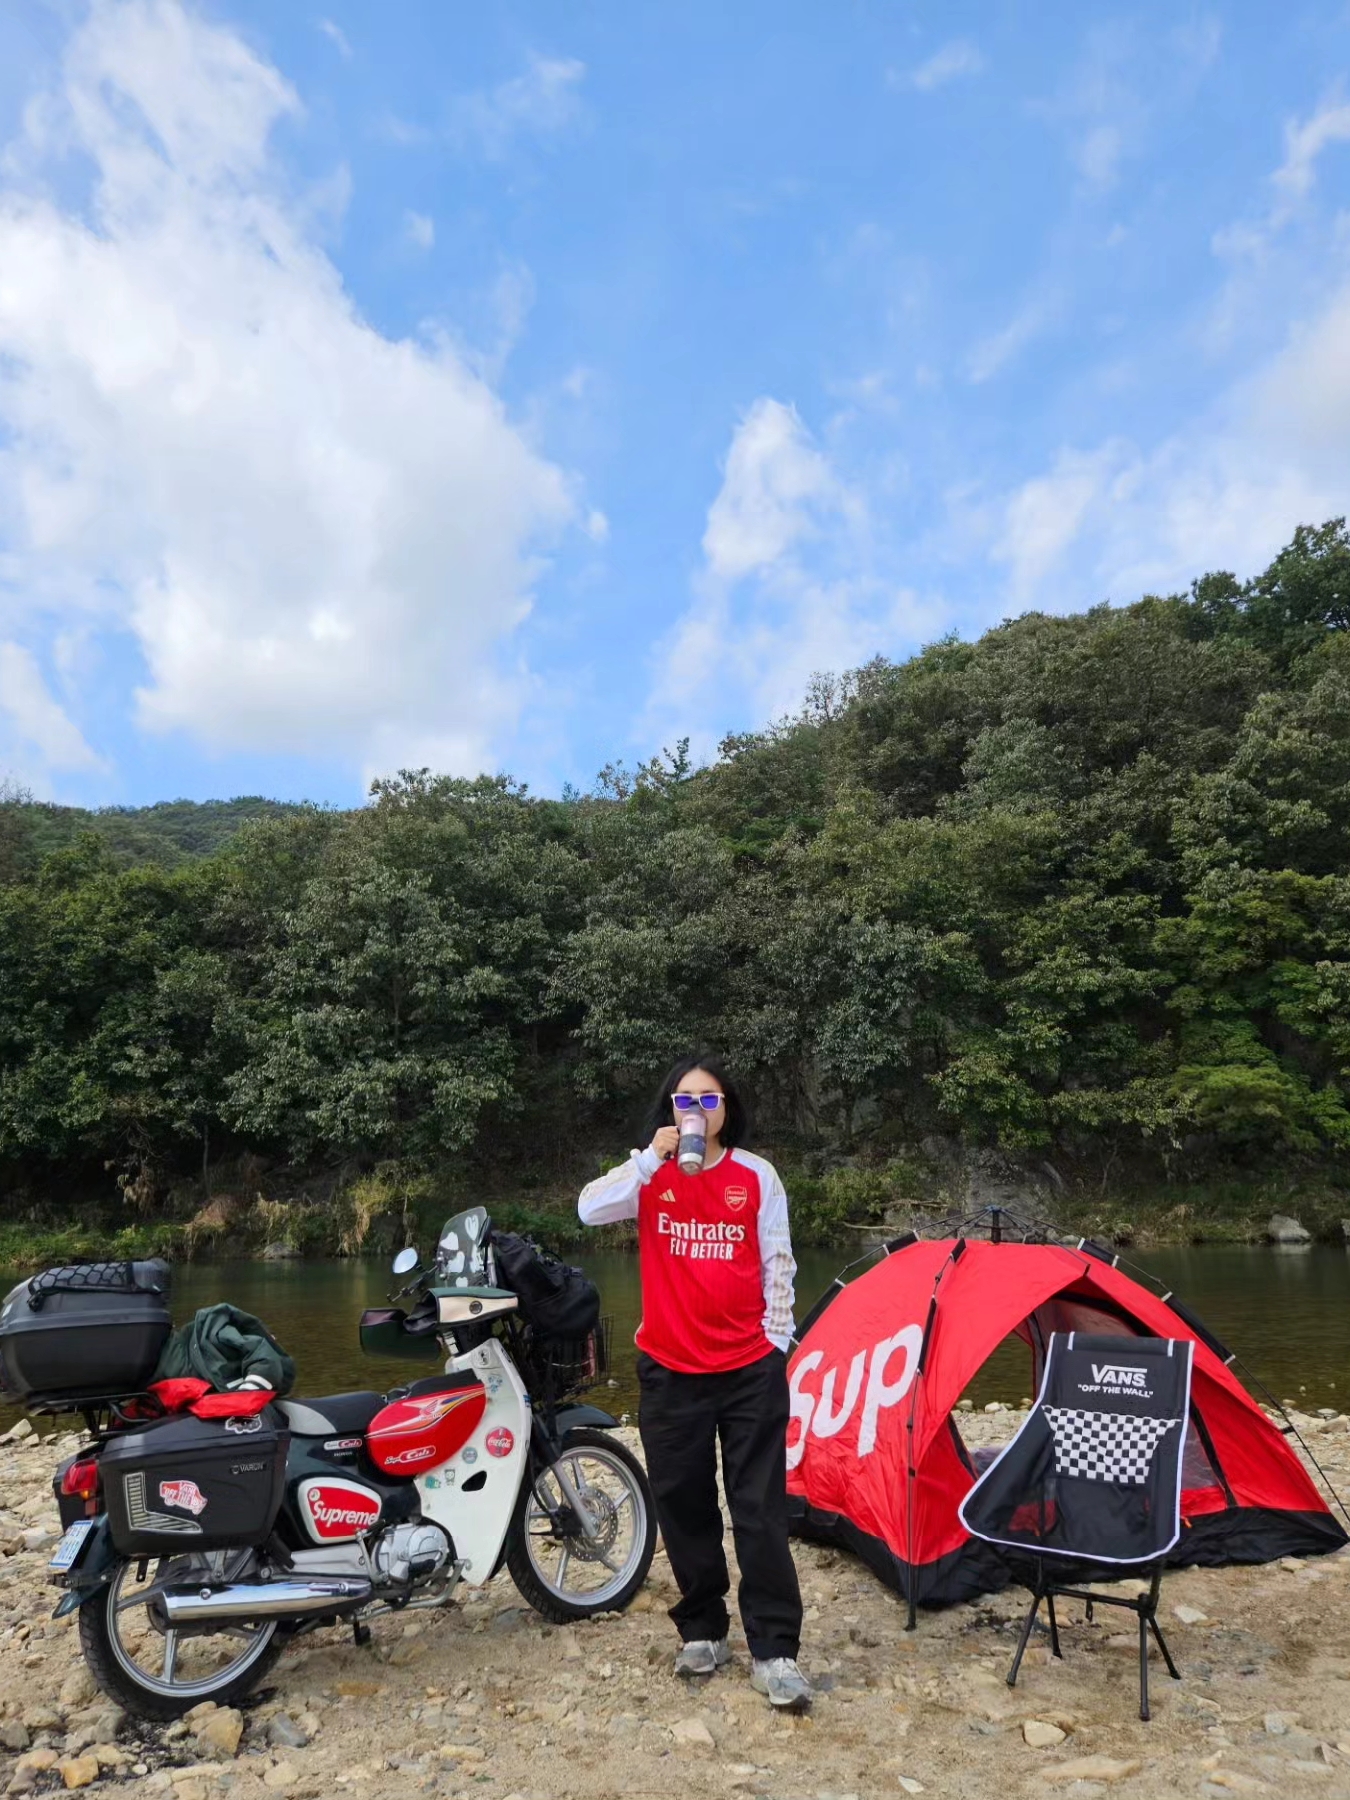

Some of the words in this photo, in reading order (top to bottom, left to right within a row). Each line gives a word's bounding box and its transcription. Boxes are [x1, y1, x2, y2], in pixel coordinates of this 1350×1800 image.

[658, 1212, 745, 1242] Emirates
[670, 1237, 687, 1256] FLY
[690, 1242, 733, 1260] BETTER
[1091, 1363, 1148, 1388] VANS
[1077, 1383, 1101, 1393] "OFF
[1102, 1386, 1121, 1394] THE
[1122, 1387, 1154, 1399] WALL"
[313, 1500, 380, 1528] Supreme
